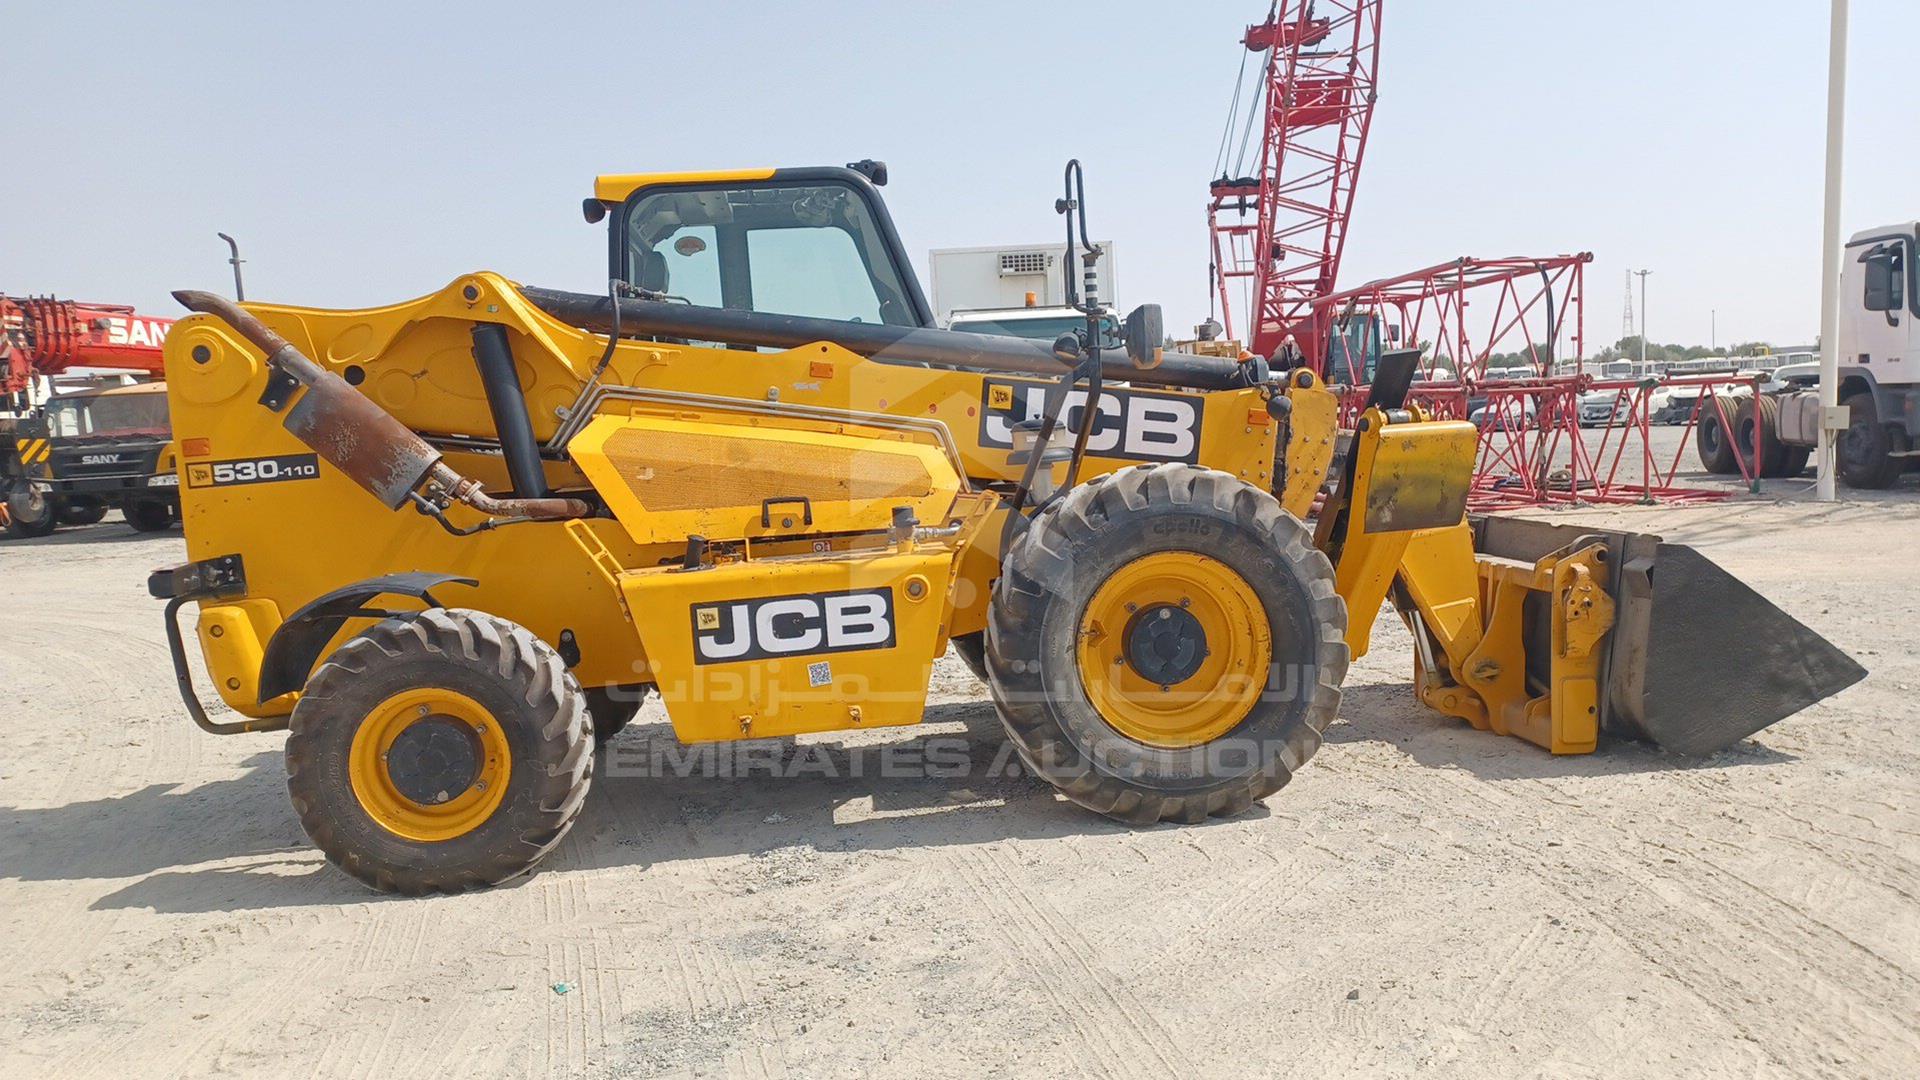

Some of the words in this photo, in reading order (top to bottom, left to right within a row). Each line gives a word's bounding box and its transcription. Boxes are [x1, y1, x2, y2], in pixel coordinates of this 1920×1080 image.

[109, 318, 174, 347] SAN
[986, 387, 1196, 458] JCB
[82, 455, 119, 464] SANY
[699, 593, 890, 658] JCB
